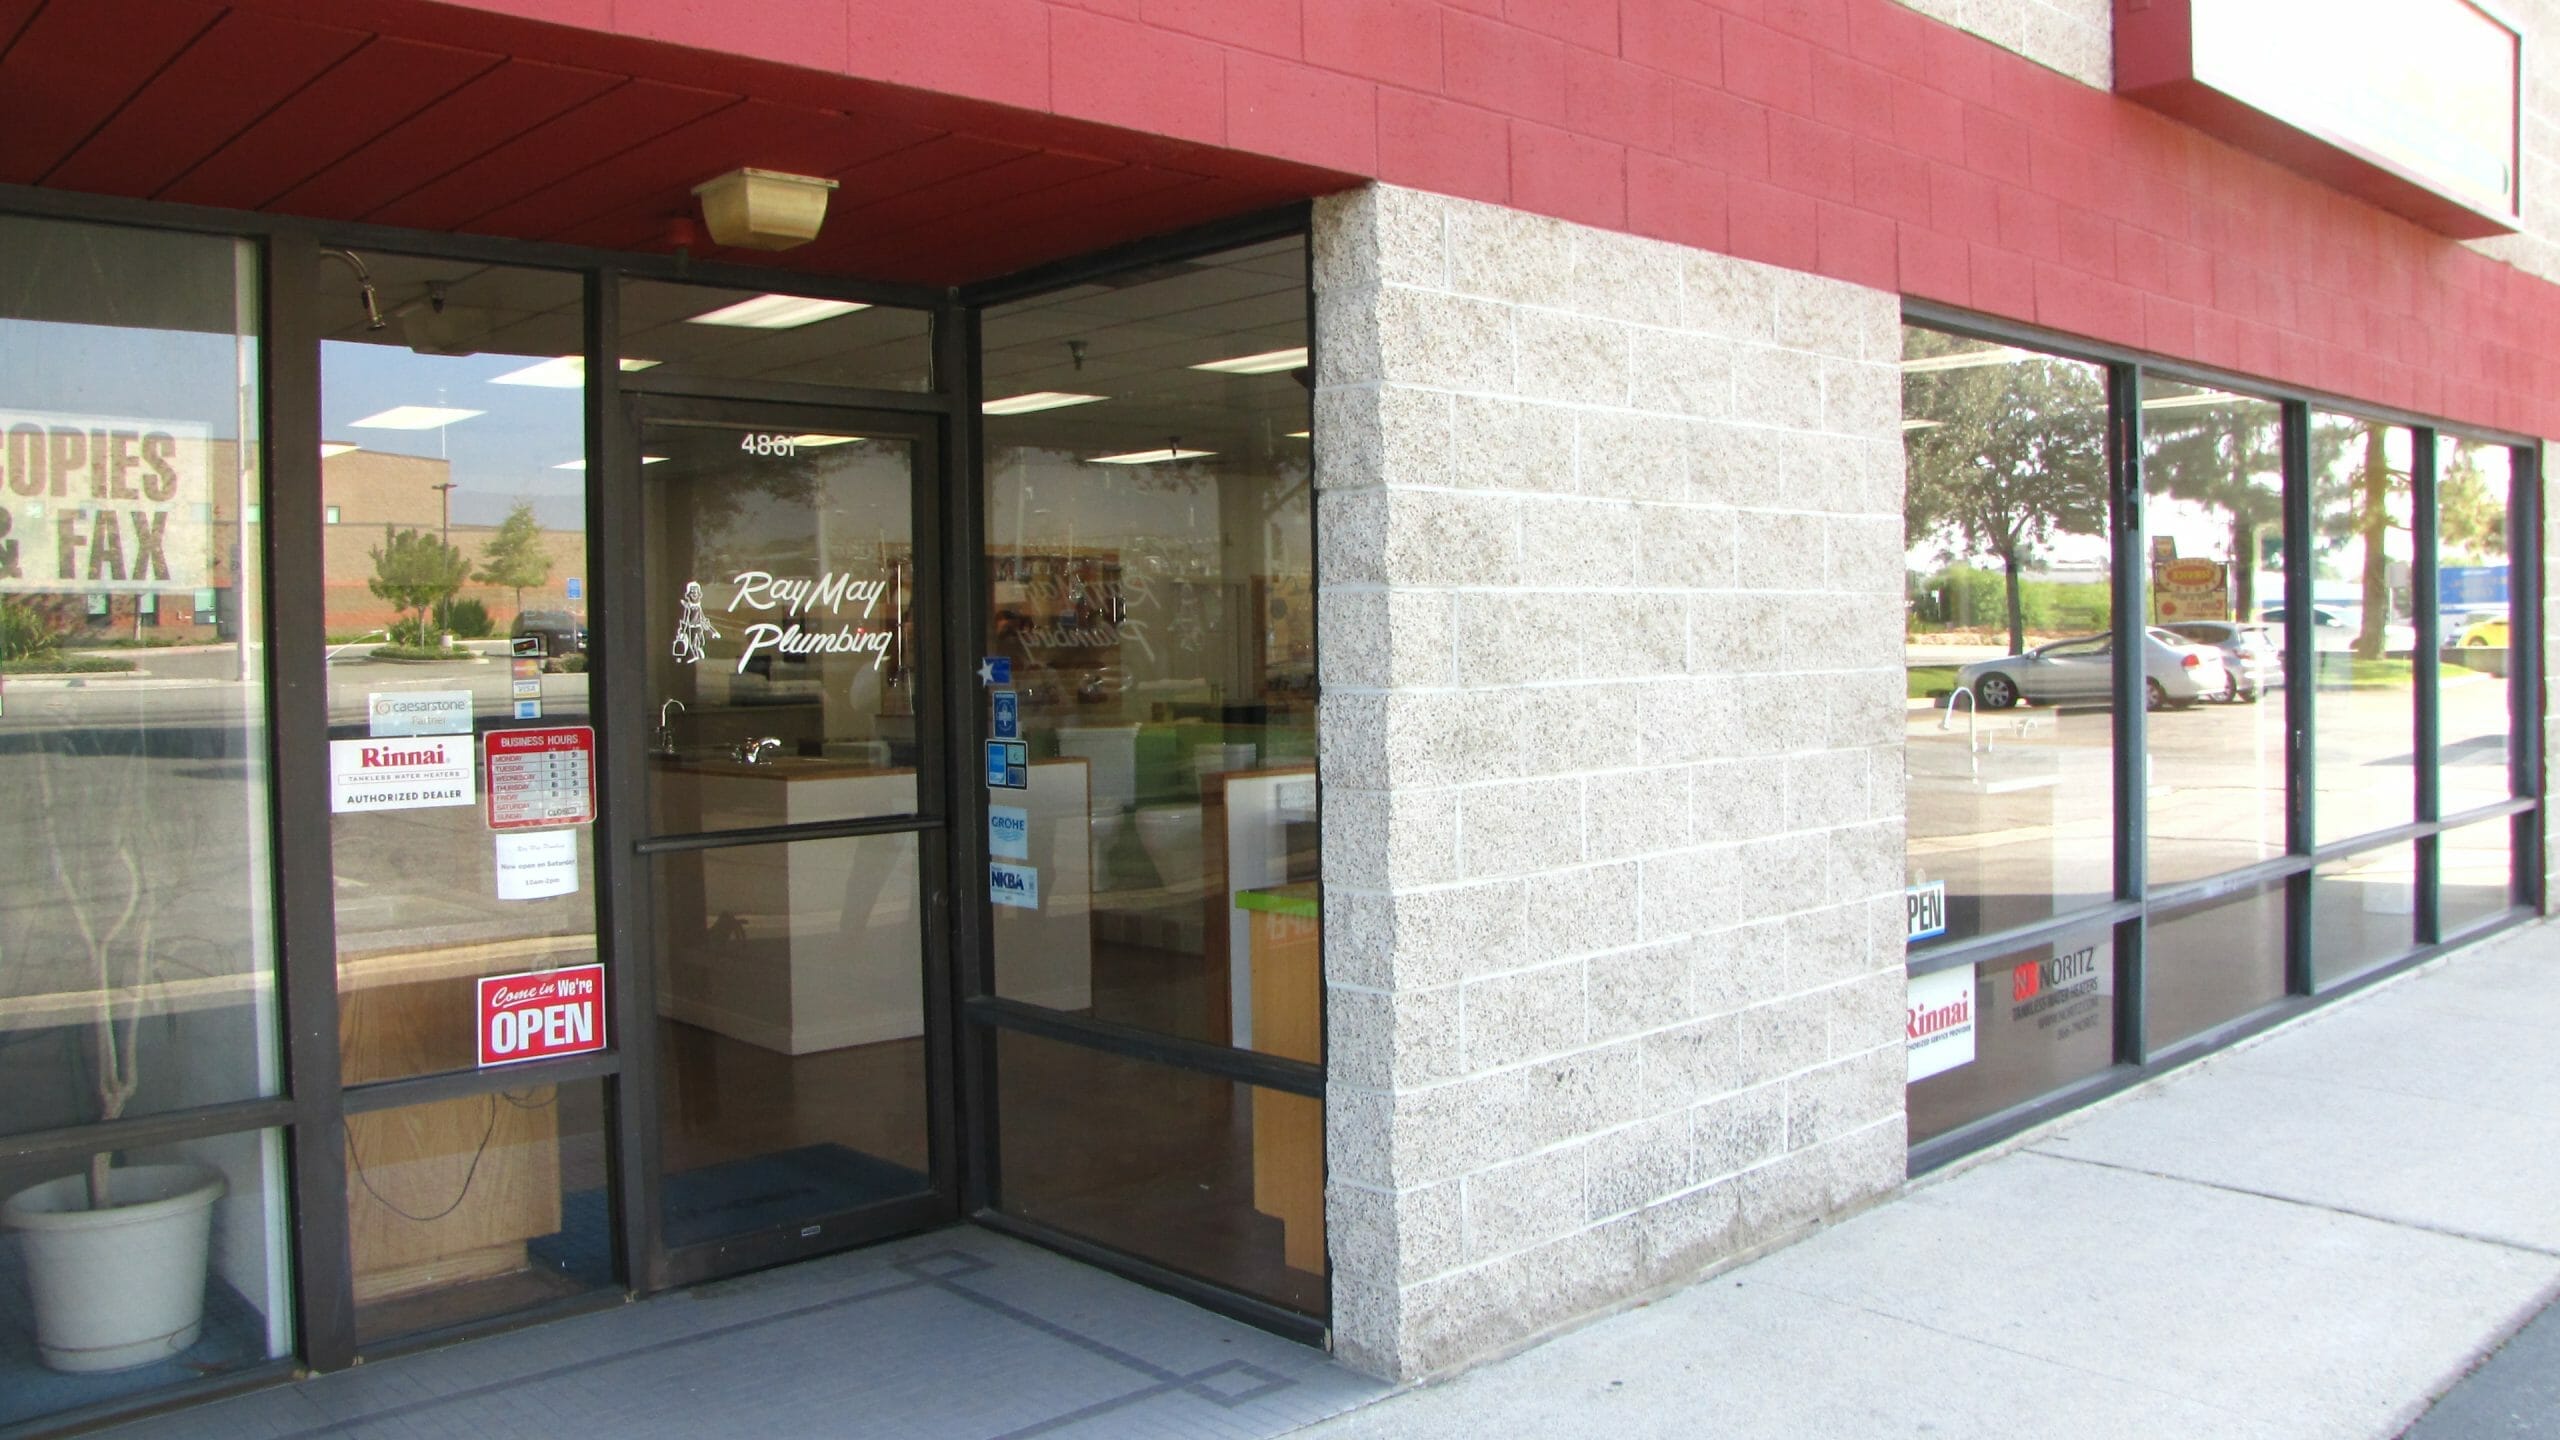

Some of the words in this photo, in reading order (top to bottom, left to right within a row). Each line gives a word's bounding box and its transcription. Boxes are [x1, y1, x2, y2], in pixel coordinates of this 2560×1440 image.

[0, 422, 179, 501] OPIES
[57, 508, 172, 582] FAX
[737, 623, 893, 674] Plumbing
[393, 699, 466, 713] caesarstone
[501, 735, 545, 747] BUSINESS
[547, 734, 579, 745] HOURS
[361, 743, 445, 768] Rinnai
[349, 773, 391, 782] TANKLESS
[395, 772, 421, 780] WATER
[424, 771, 460, 779] HEATERS
[347, 791, 419, 804] AUTHORIZED
[423, 789, 462, 800] DEALER
[991, 814, 1025, 831] GROHE
[991, 869, 1024, 891] NKBA
[1908, 889, 1942, 934] PEN
[2039, 946, 2095, 989] NORITZ
[491, 985, 537, 1007] Come
[539, 982, 555, 997] in
[557, 979, 593, 998] We're
[1906, 989, 1969, 1039] Rinnai
[491, 1001, 593, 1054] OPEN
[1906, 1037, 1930, 1050] THORIZED
